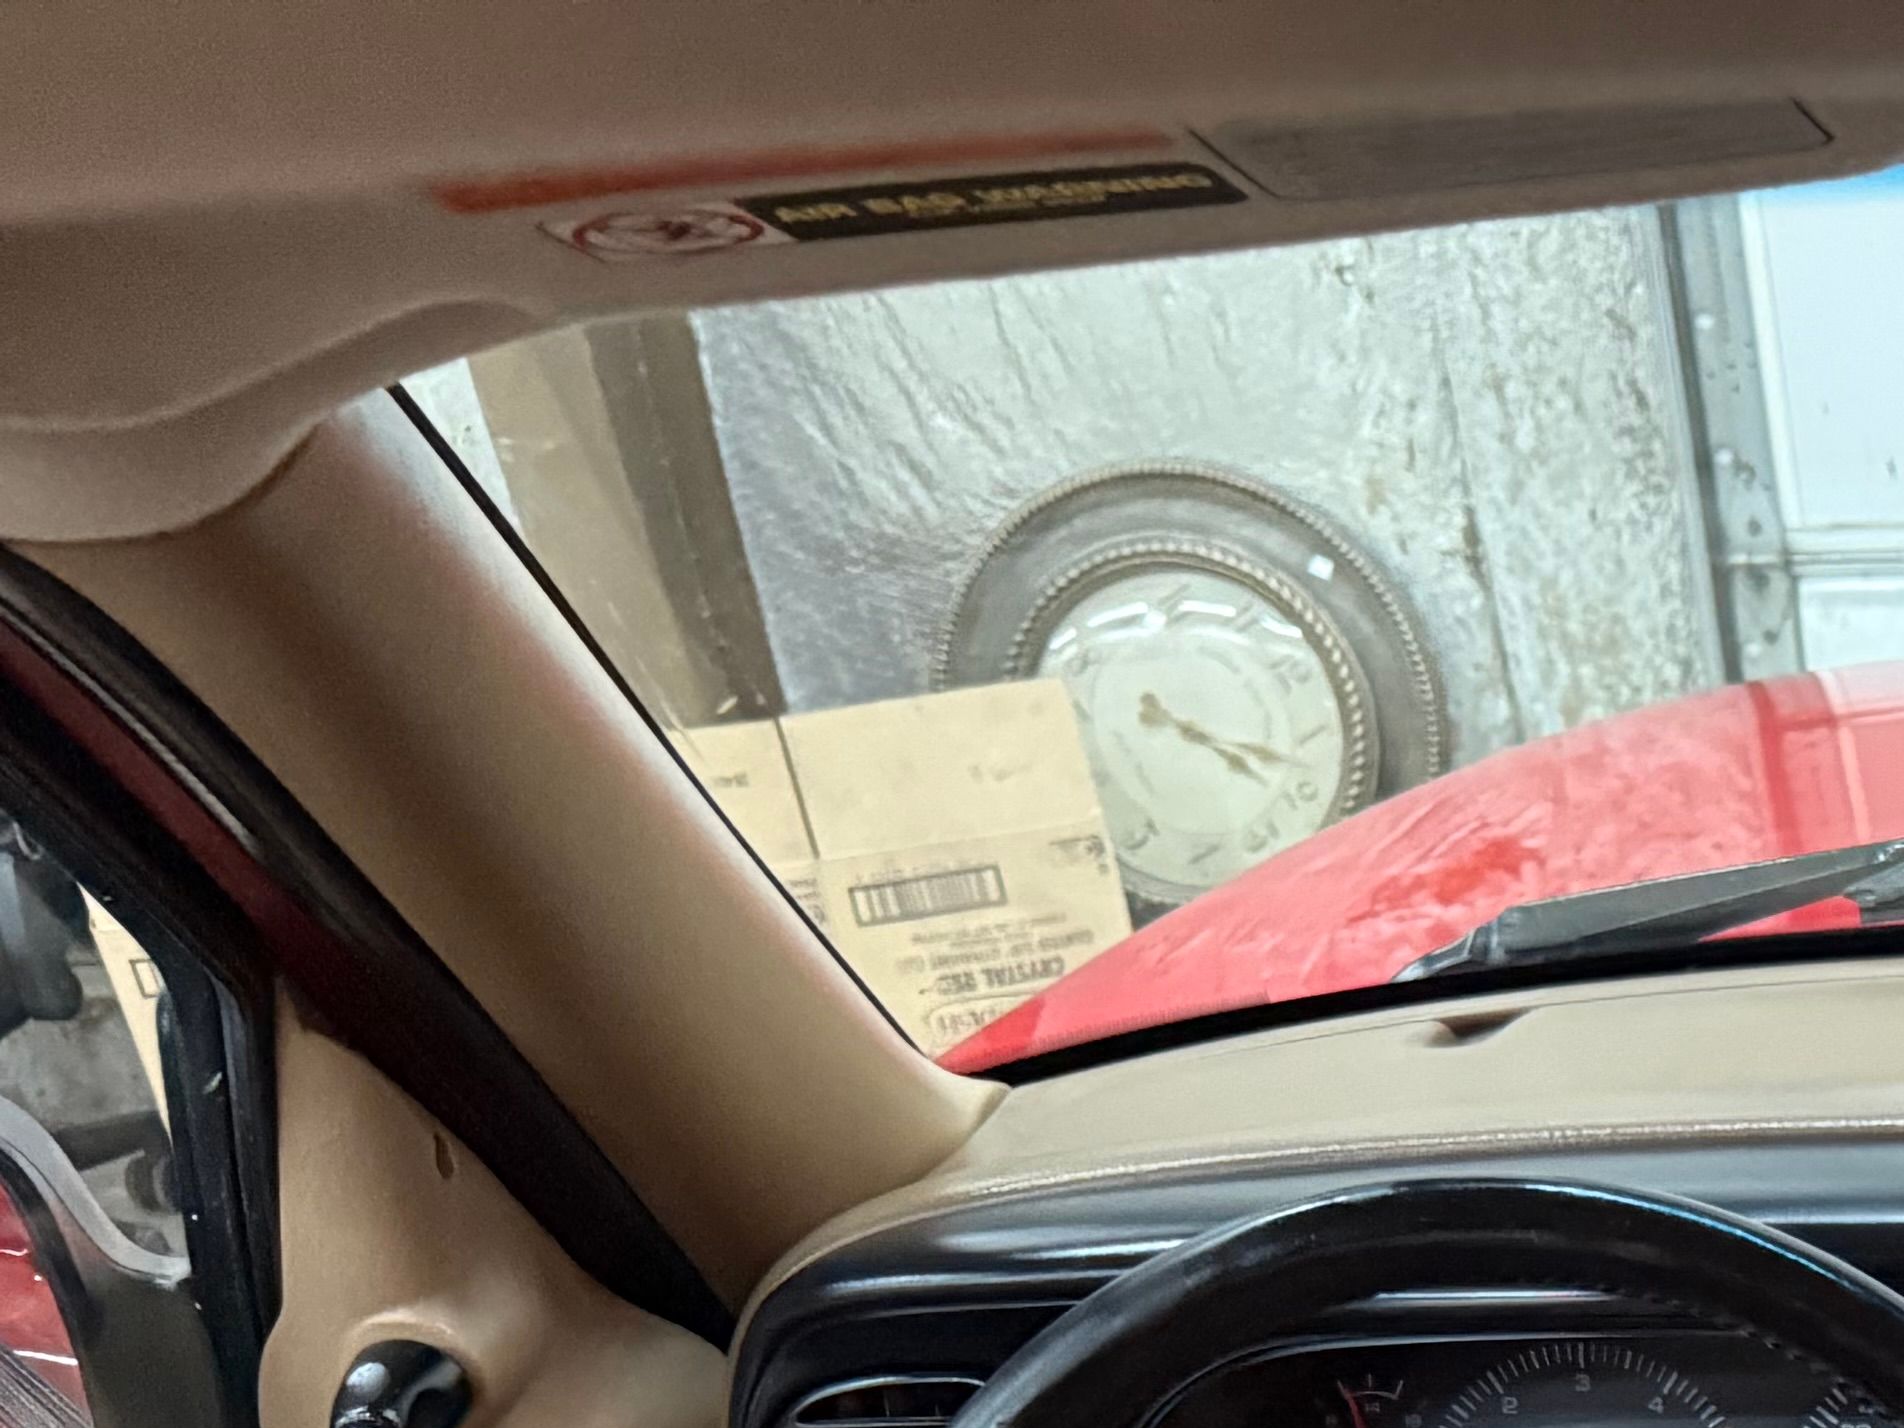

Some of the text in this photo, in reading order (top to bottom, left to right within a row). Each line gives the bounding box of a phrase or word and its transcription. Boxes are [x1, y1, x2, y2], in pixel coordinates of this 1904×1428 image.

[776, 202, 857, 222] AIR
[1575, 1373, 1592, 1392] 3
[1502, 1396, 1519, 1415] 2
[1648, 1396, 1664, 1415] 4
